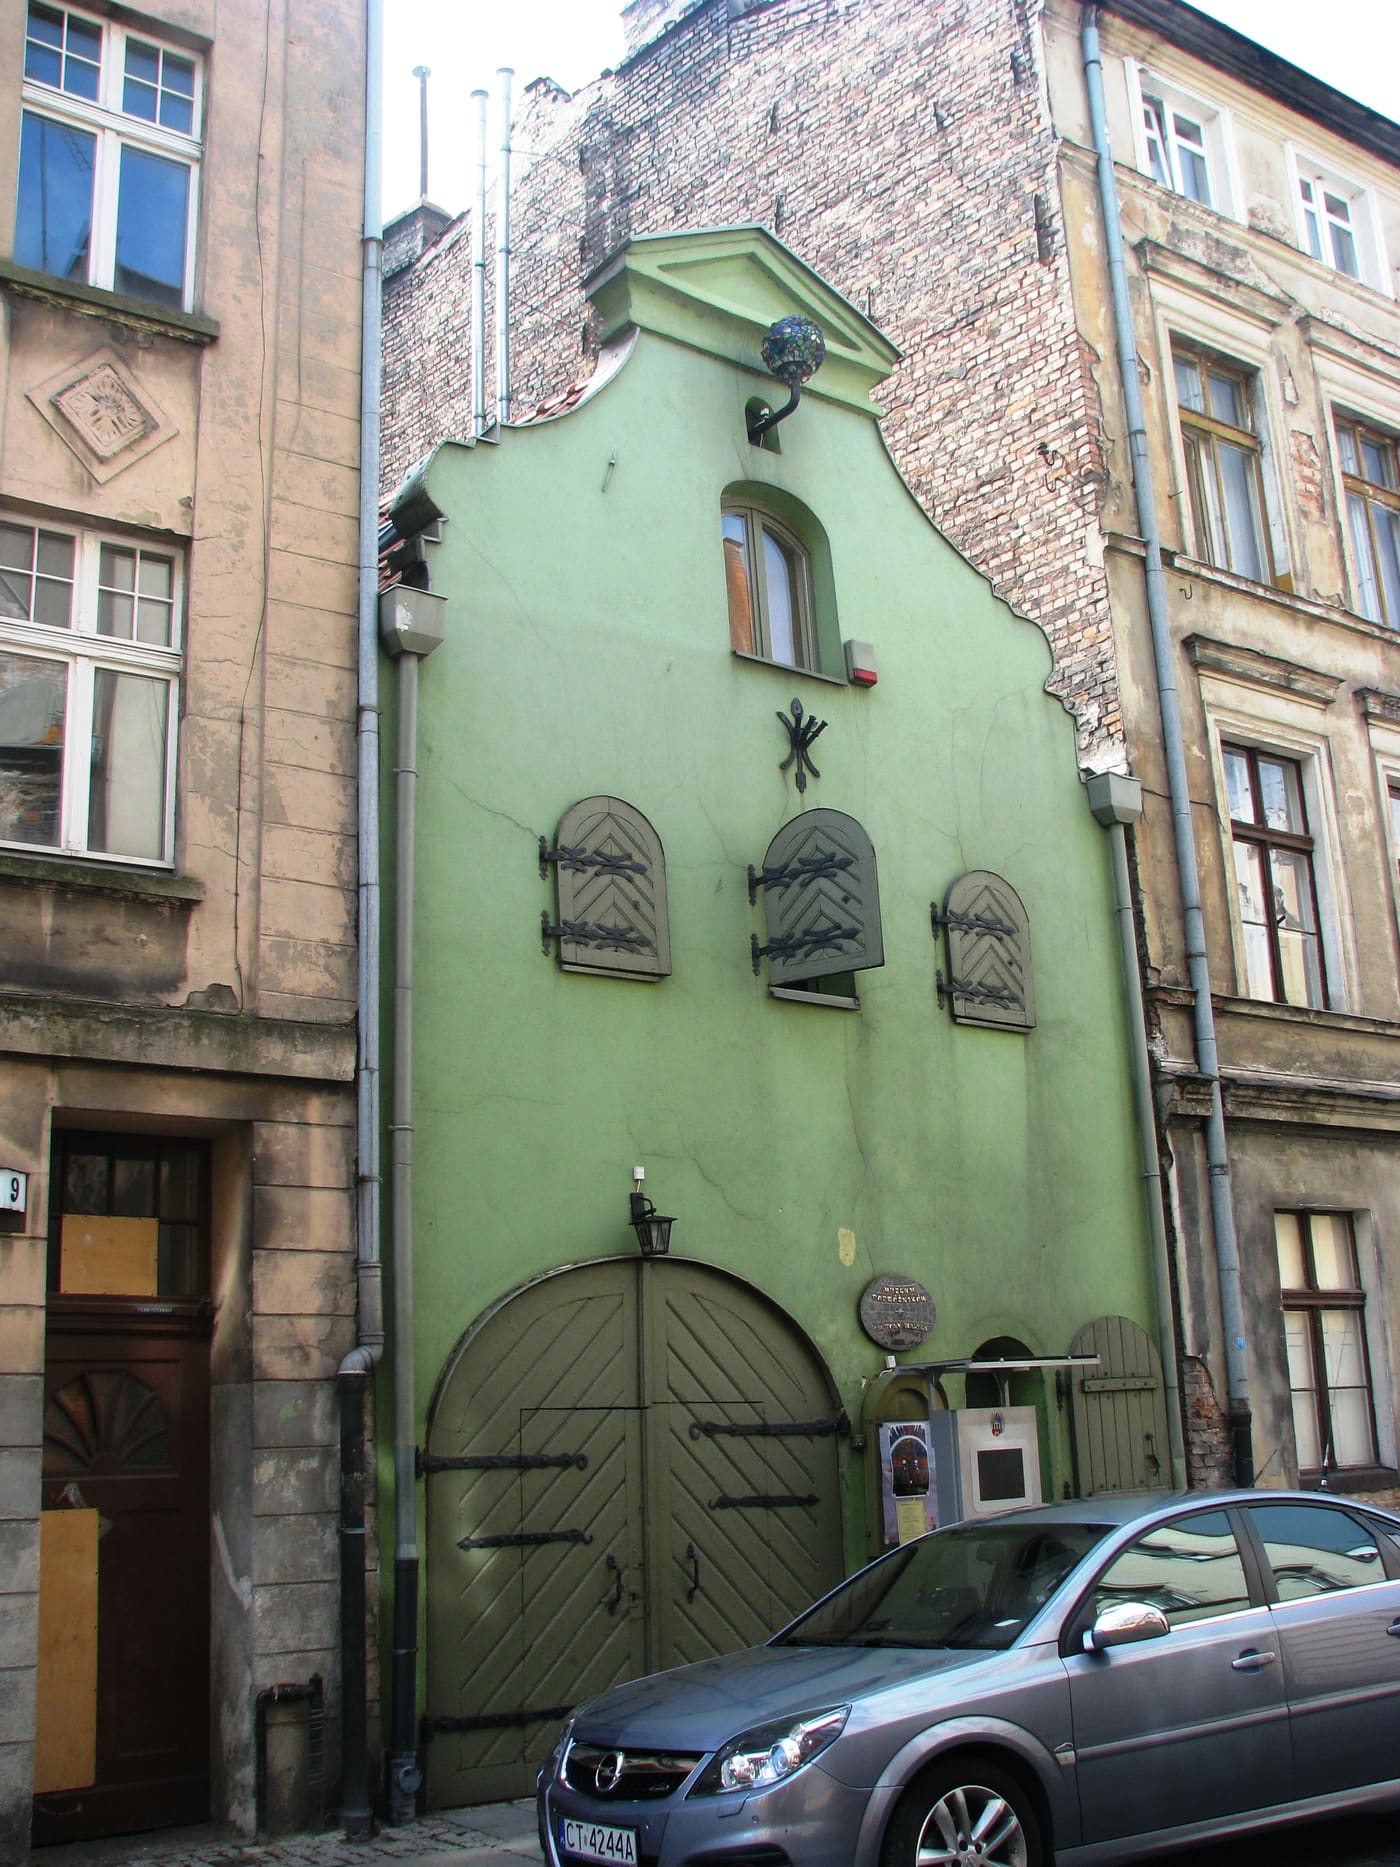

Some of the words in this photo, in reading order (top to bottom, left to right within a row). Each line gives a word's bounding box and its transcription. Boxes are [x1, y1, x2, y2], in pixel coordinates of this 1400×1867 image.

[10, 1177, 20, 1202] 9
[566, 1822, 583, 1851] CT
[590, 1827, 634, 1861] 4244A
